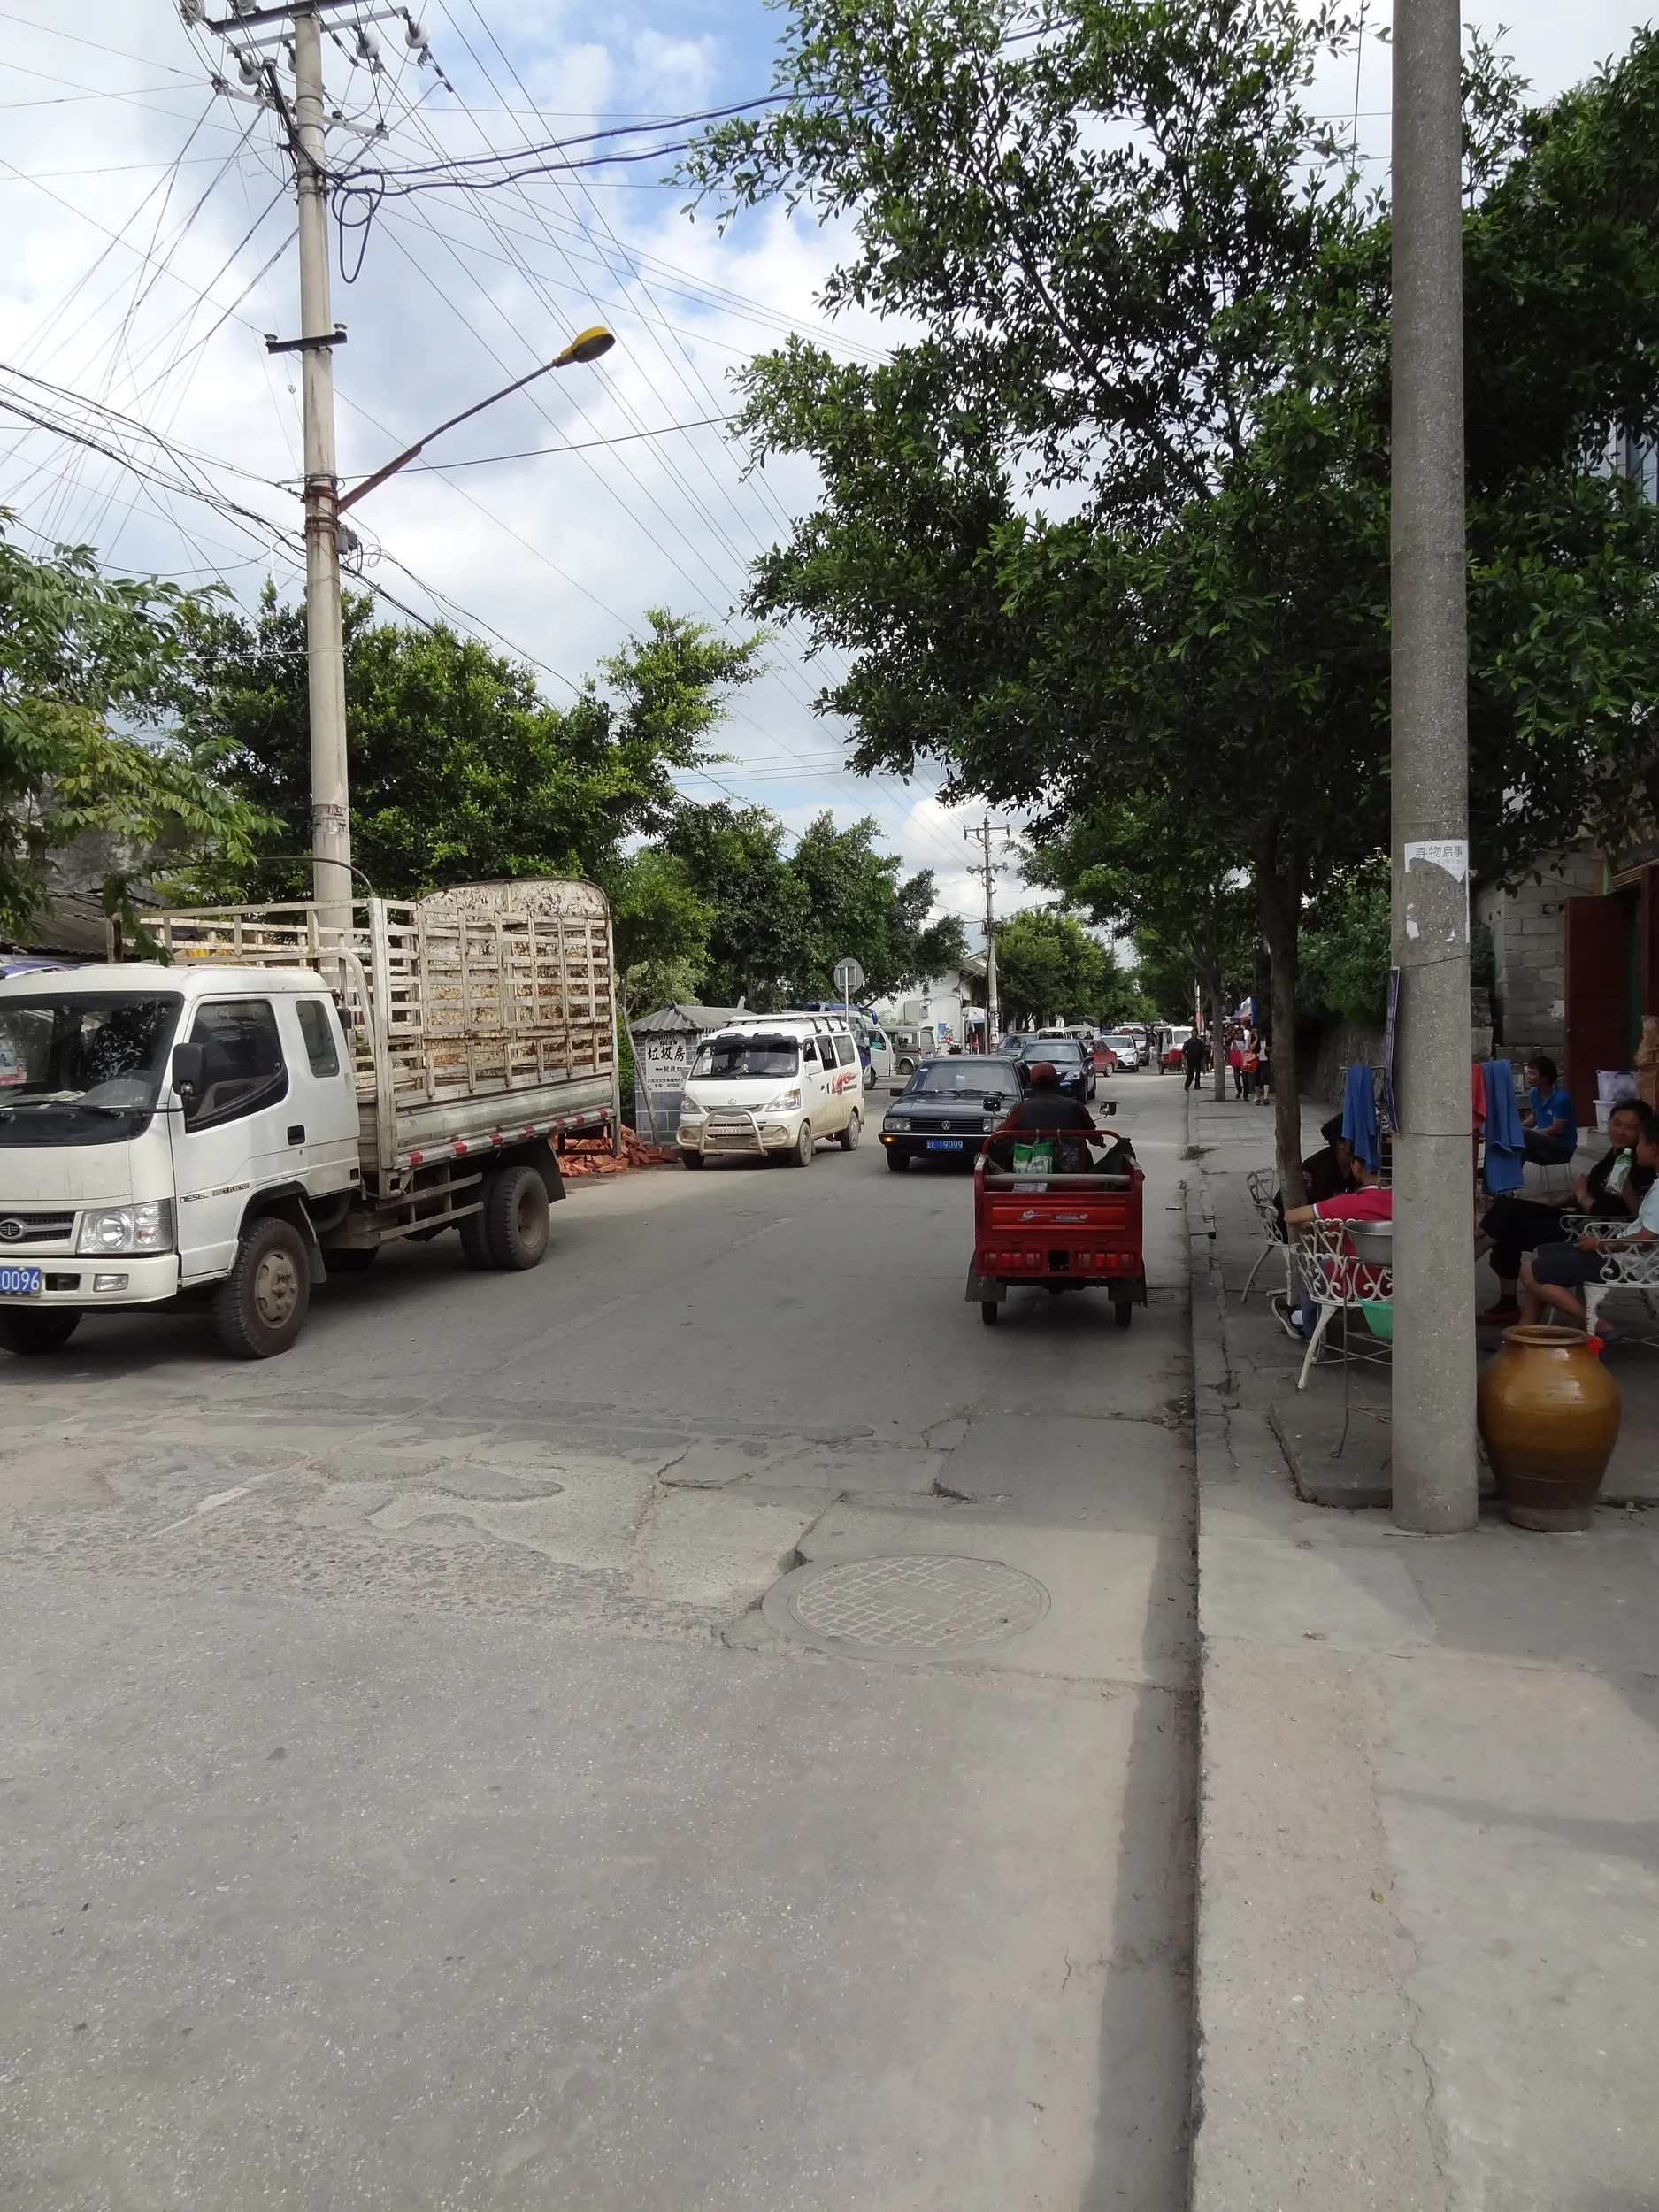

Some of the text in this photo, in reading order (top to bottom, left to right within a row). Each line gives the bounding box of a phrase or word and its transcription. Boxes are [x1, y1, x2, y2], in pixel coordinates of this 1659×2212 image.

[1416, 845, 1463, 858] 寻物启事
[648, 1046, 685, 1062] 垃圾房
[180, 1192, 208, 1203] DIESEL
